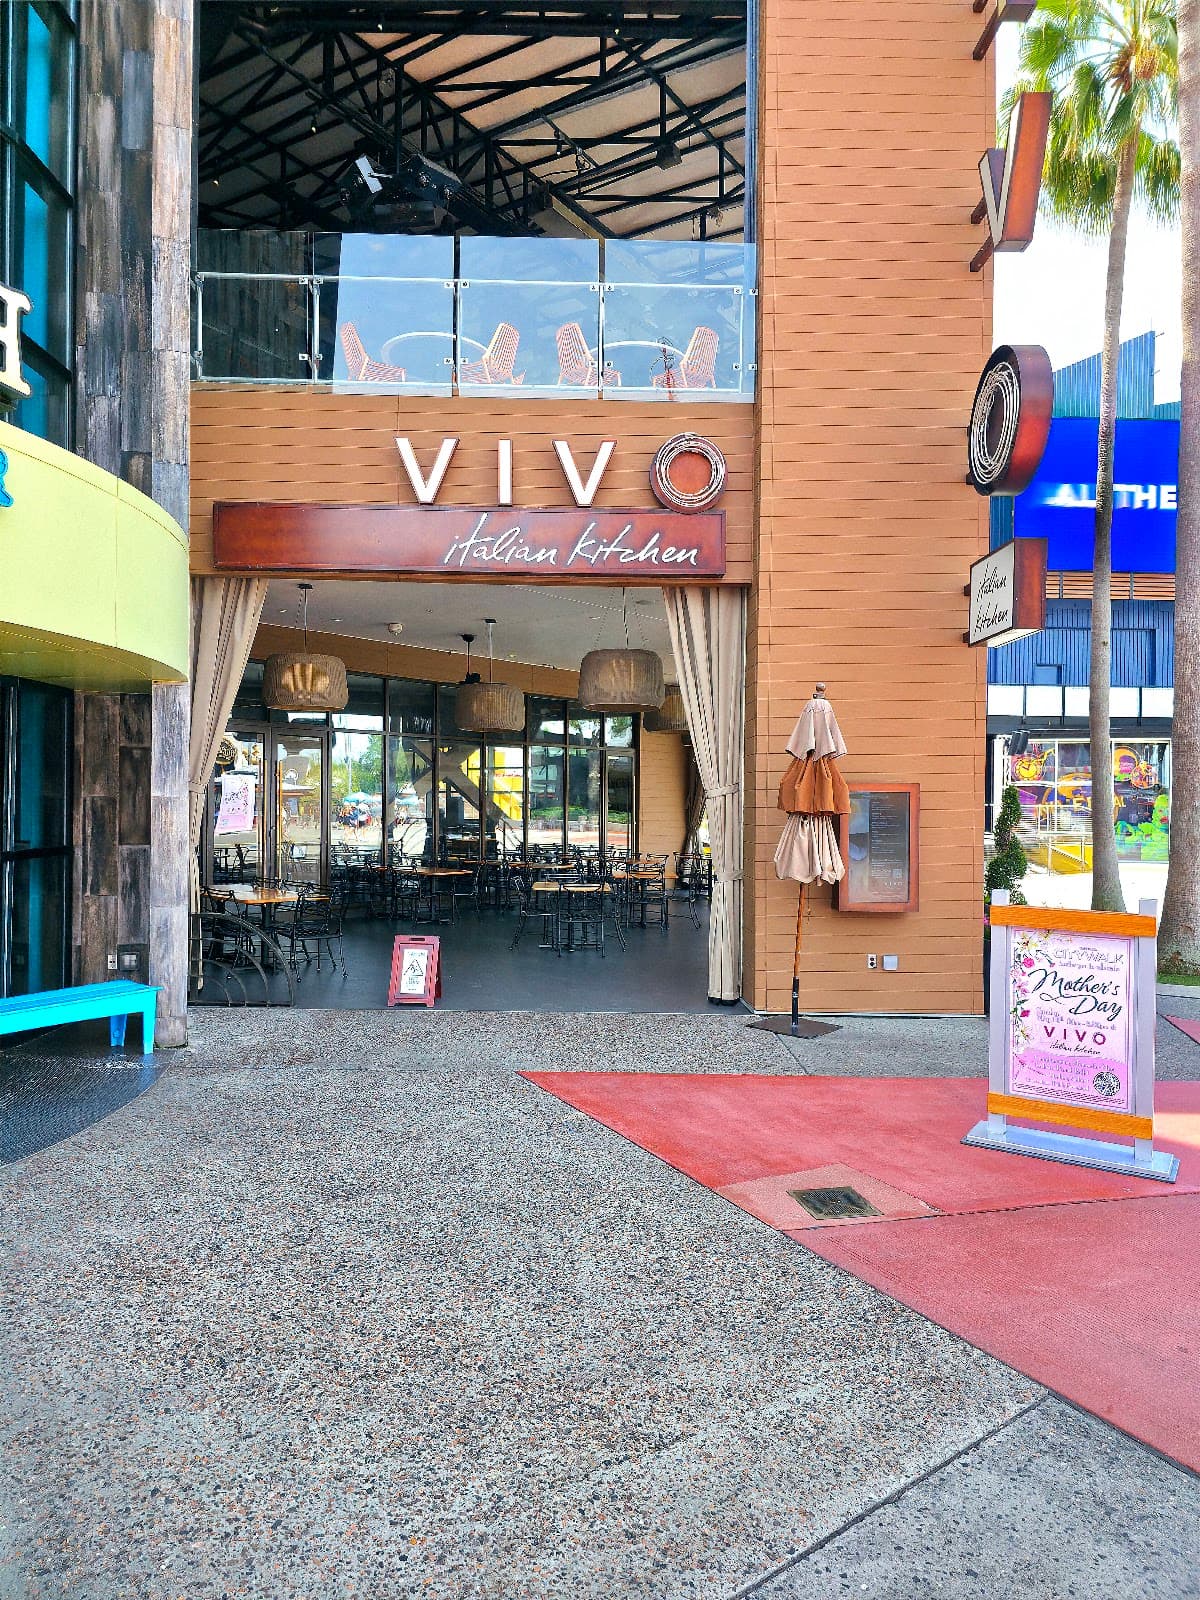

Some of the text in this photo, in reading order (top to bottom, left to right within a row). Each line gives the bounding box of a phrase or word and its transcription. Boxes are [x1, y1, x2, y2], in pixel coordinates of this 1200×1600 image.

[394, 431, 729, 514] VIVO
[443, 512, 699, 567] italian kitchen
[1028, 968, 1121, 998] Mother's
[1058, 994, 1123, 1022] Day
[1043, 1025, 1107, 1046] VIVO
